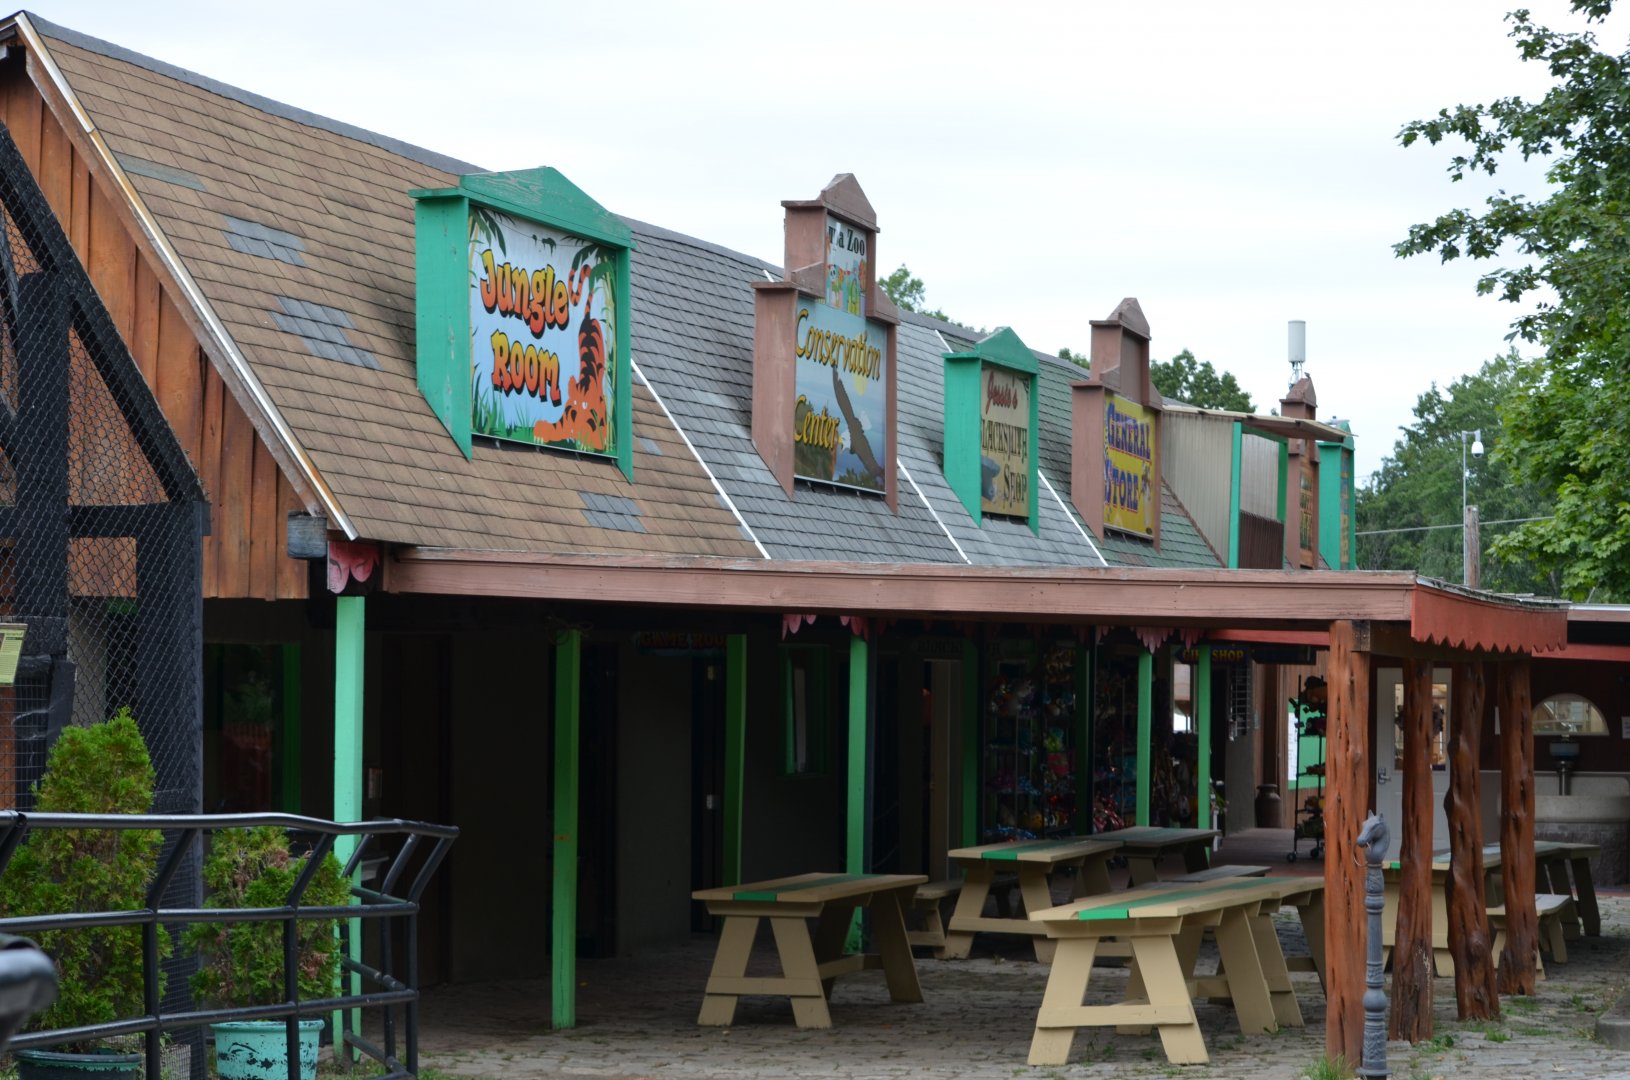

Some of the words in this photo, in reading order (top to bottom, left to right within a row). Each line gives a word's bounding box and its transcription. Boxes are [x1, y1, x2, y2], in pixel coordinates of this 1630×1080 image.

[847, 227, 865, 257] Zoo
[479, 248, 571, 340] Jungle
[795, 308, 882, 382] Conservation
[793, 393, 841, 449] Center
[981, 418, 1028, 464] LACKSMITH
[1107, 400, 1152, 464] GENERAL
[1104, 458, 1140, 514] STORE
[691, 631, 727, 648] ROO
[1212, 648, 1244, 661] SHOP
